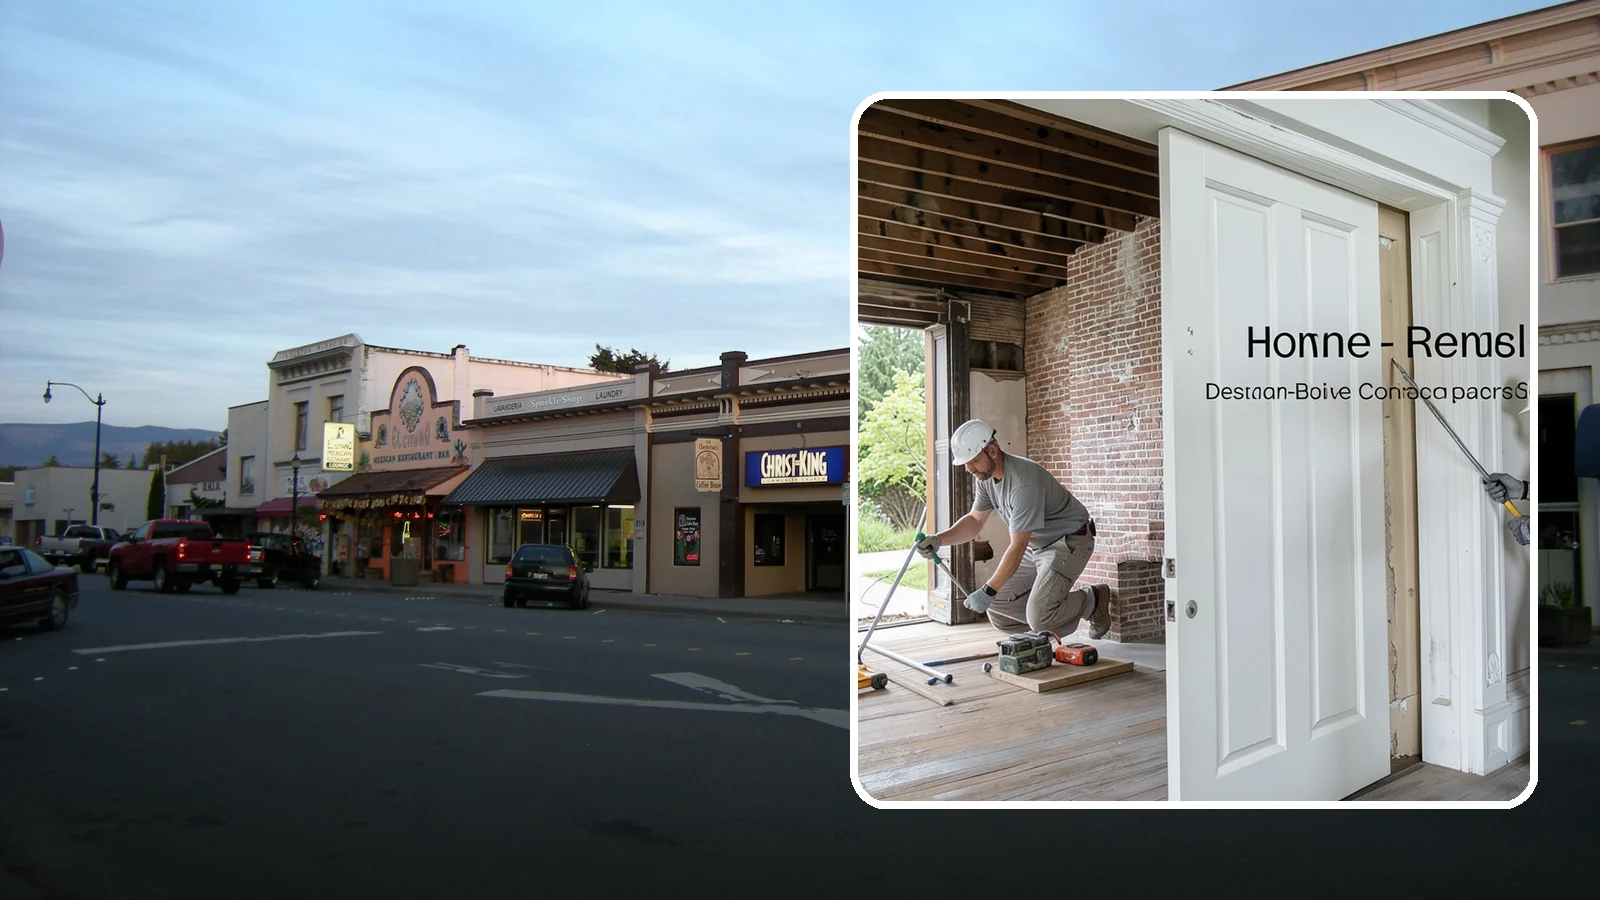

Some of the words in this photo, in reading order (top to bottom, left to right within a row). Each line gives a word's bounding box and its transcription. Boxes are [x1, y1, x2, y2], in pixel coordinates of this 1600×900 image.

[493, 402, 523, 413] LAVANDERIA
[530, 397, 562, 410] Sparkle
[562, 394, 582, 405] Shop
[595, 389, 623, 400] LAUNDRY
[397, 452, 433, 462] RESTAURANT
[438, 450, 450, 458] BAR
[761, 452, 797, 478] CHRIST
[799, 450, 827, 476] KING
